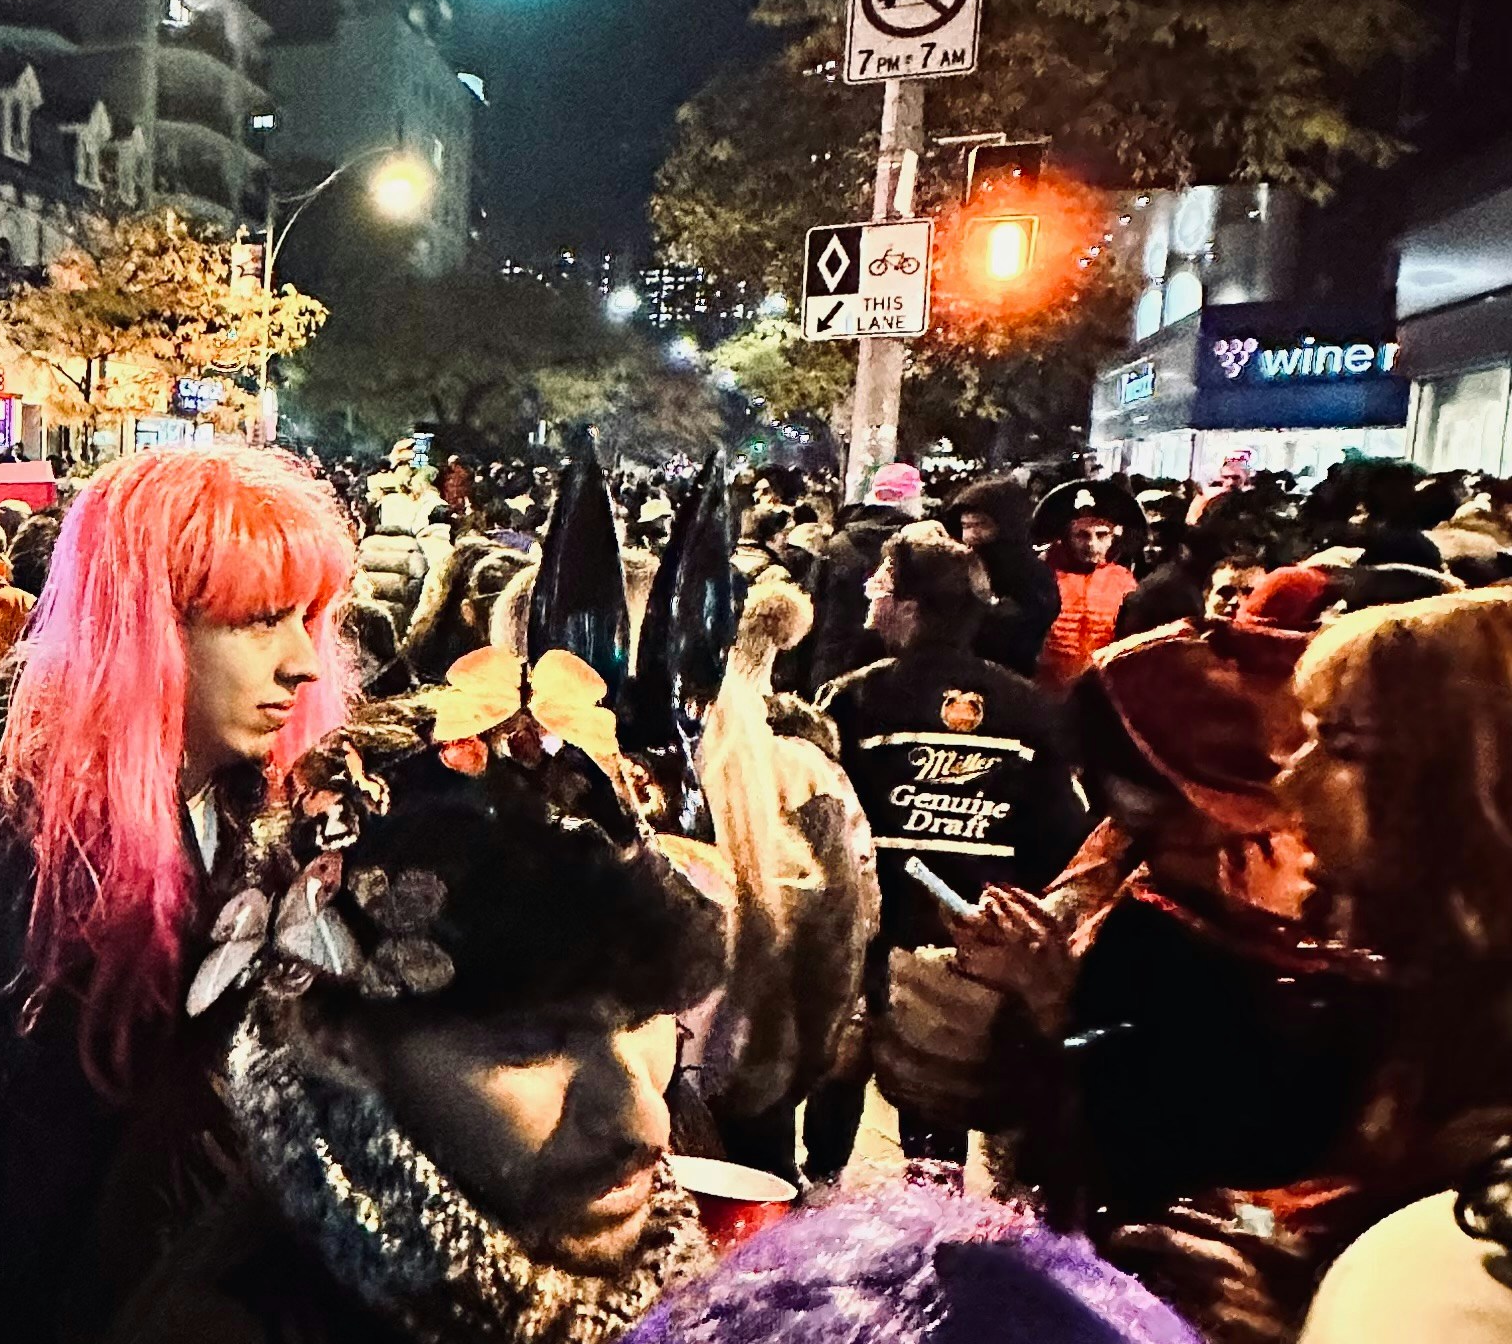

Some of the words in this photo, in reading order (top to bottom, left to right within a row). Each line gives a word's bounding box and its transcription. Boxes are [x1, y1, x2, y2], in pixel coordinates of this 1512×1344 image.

[863, 296, 903, 312] THIS
[857, 315, 906, 331] LANE
[1259, 336, 1375, 377] wine
[908, 746, 1002, 782] Miller
[889, 784, 1011, 819] Genuine
[902, 808, 991, 839] Draft
